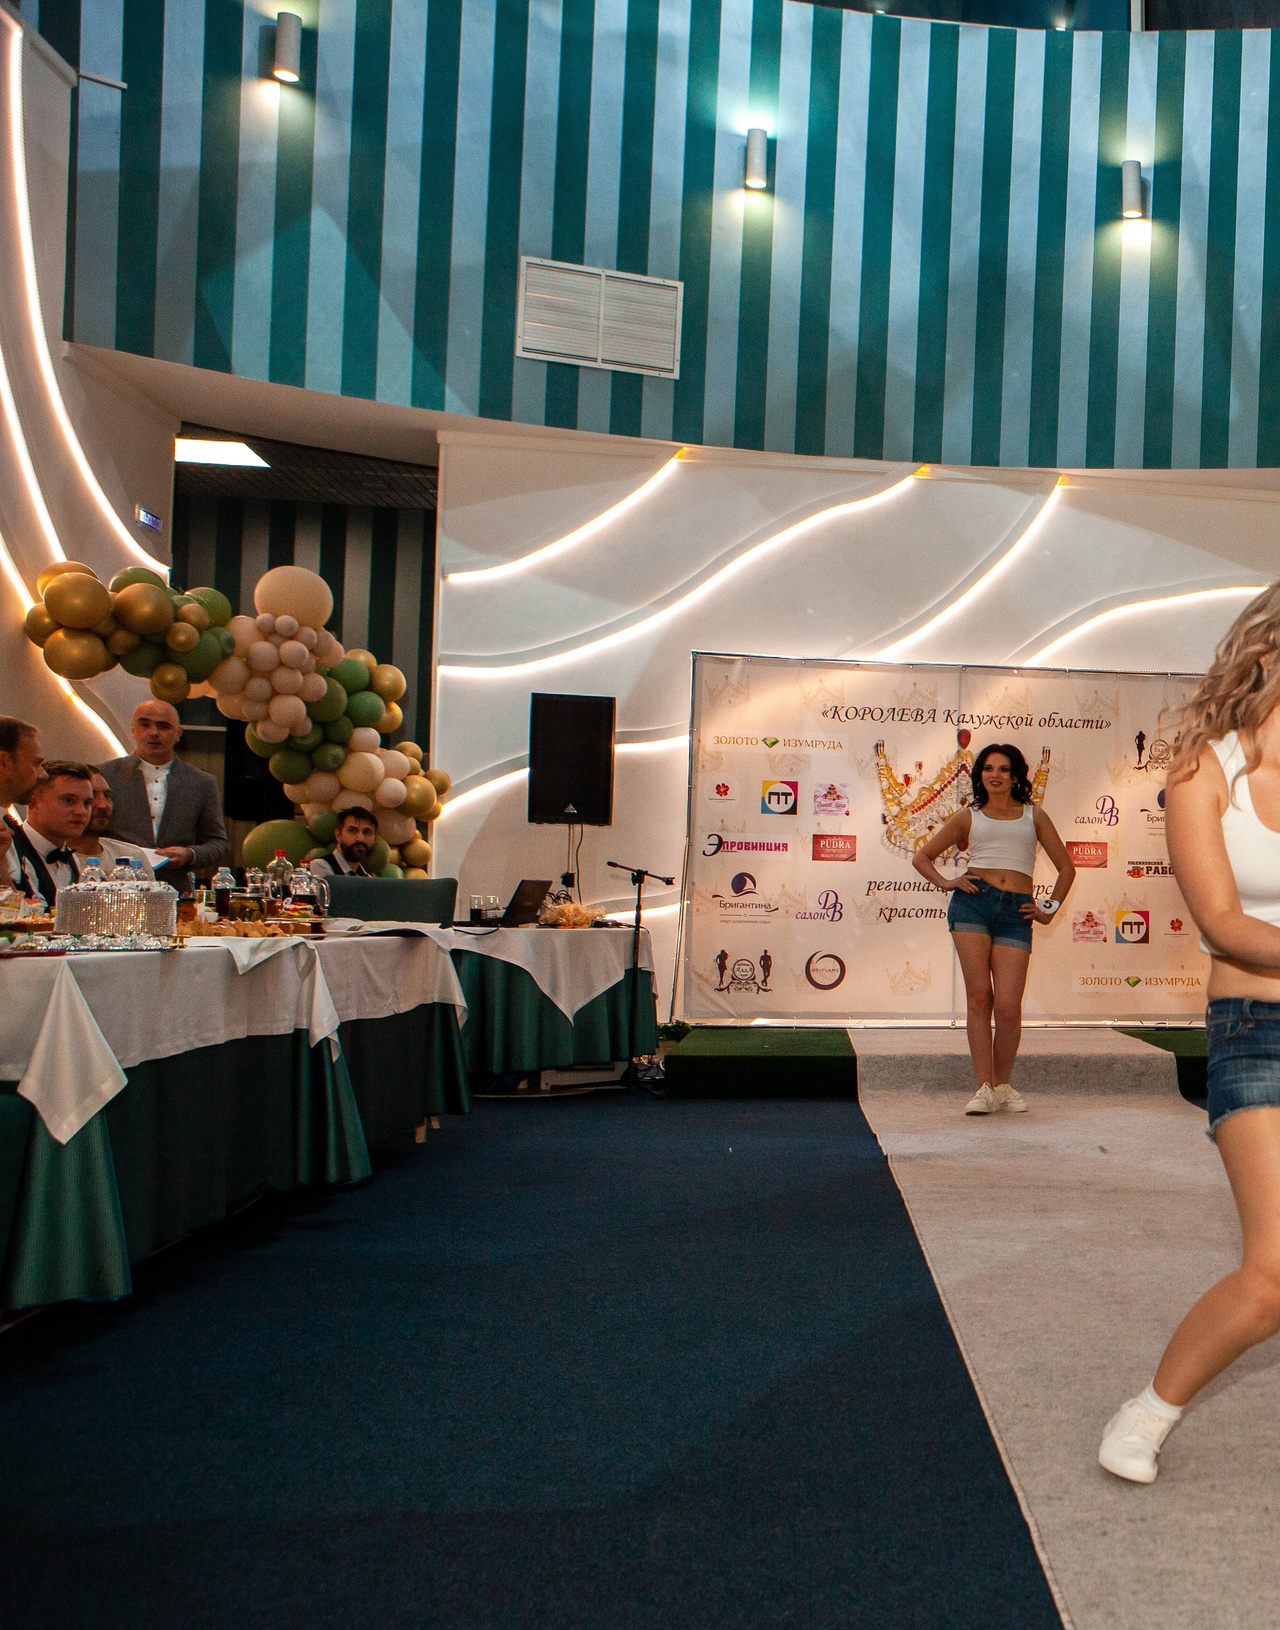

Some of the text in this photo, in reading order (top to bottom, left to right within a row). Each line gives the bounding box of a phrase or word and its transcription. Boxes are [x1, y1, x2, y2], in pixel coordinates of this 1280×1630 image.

[821, 705, 1112, 731] «КОРОЛЕВА Калужской области»
[712, 736, 844, 750] ЗОЛОТО ИЗУМРУДА
[768, 791, 792, 805] ПТ
[1074, 816, 1103, 825] салон
[820, 840, 851, 849] PUDRA
[1073, 847, 1103, 856] PUDRA
[1145, 866, 1175, 875] РАБО
[719, 899, 771, 911] Бригантина
[1043, 900, 1054, 909] 5
[795, 911, 826, 920] салон
[1121, 921, 1144, 934] ПТ
[1079, 977, 1201, 987] ЗОЛОТО ИЗУМРУДА
